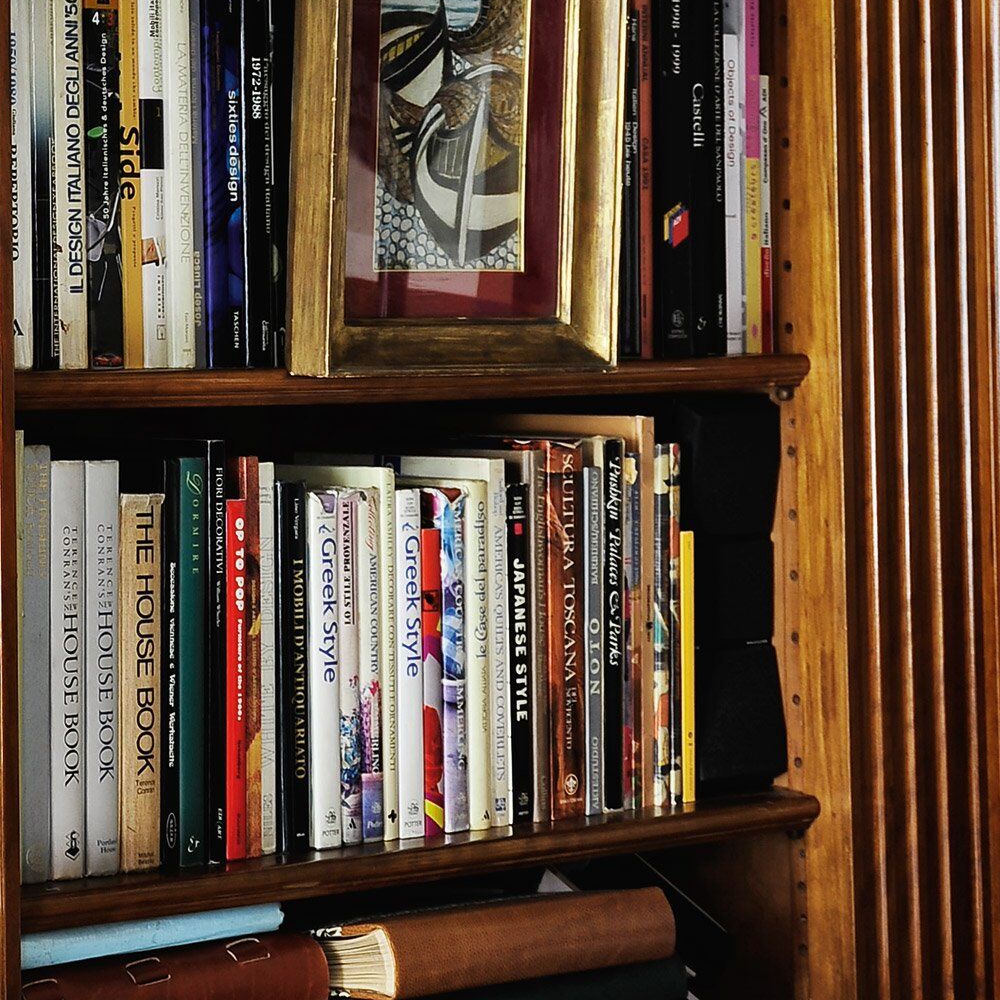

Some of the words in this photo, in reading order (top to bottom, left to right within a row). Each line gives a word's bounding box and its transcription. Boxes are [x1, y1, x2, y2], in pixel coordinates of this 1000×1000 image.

[64, 19, 80, 63] ANNI
[99, 32, 108, 64] Design
[176, 41, 188, 63] LA
[671, 43, 681, 75] 1999
[65, 61, 81, 119] DEGLI
[100, 67, 108, 112] deutsches
[177, 66, 190, 125] MATERIA
[251, 55, 263, 120] 1972-1988
[726, 59, 738, 106] Objects
[227, 89, 240, 144] sixties
[691, 82, 705, 148] Castelli
[728, 110, 738, 123] of
[66, 124, 82, 203] ITALIANO
[101, 124, 109, 180] italienisches
[118, 125, 141, 201] Side
[226, 145, 241, 202] design
[727, 125, 739, 168] Design
[102, 208, 110, 220] 50
[178, 131, 192, 263] DELL'INVENZIONE
[68, 208, 84, 275] DESIGN
[69, 279, 84, 293] IL
[232, 310, 240, 349] TASCHEN
[214, 466, 224, 499] FIORI
[293, 497, 301, 514] Lino
[562, 452, 576, 570] SCULTURA
[606, 456, 622, 521] Pushkin
[135, 504, 155, 564] THE
[186, 470, 204, 576] DORMIRE
[214, 501, 225, 574] DECORATIVI
[235, 516, 245, 541] OP
[342, 500, 351, 572] PROVENZALE
[365, 496, 378, 551] Collecting
[386, 519, 394, 558] ASHLEY
[475, 500, 489, 573] paradiso
[535, 496, 547, 600] Englishwoman's
[62, 525, 72, 603] CONRAN'S
[70, 525, 79, 605] TERENCE
[97, 523, 106, 601] CONRAN'S
[106, 523, 114, 603] TERENCE
[235, 546, 245, 570] TO
[260, 535, 274, 625] DESIGN
[321, 536, 338, 613] Greek
[368, 552, 379, 615] AMERICAN
[404, 535, 422, 610] Greek
[494, 524, 505, 600] AMERICA'S
[608, 527, 622, 586] Palaces
[168, 561, 177, 613] Secessione
[235, 575, 246, 611] POP
[291, 569, 304, 630] MOBILI
[343, 576, 351, 608] STILE
[387, 563, 396, 626] DECORARE
[474, 577, 488, 602] del
[512, 557, 527, 657] JAPANESE
[135, 574, 156, 679] HOUSE
[169, 617, 177, 659] viennese
[236, 617, 244, 662] Furniture
[343, 610, 352, 625] LO
[369, 617, 380, 675] COUNTRY
[387, 629, 396, 647] CON
[401, 616, 422, 679] Style
[473, 605, 488, 642] Case
[494, 602, 507, 655] QUILTS
[562, 576, 578, 681] TOSCANA
[608, 614, 623, 666] Parks
[62, 612, 80, 706] HOUSE
[96, 610, 115, 703] HOUSE
[318, 620, 339, 684] Style
[475, 644, 488, 658] le
[495, 658, 507, 692] AND
[589, 617, 601, 696] NOTO
[168, 673, 177, 708] Wiener
[236, 674, 244, 689] the
[291, 634, 306, 779] D'ANTIQUARIATO
[514, 662, 528, 723] STYLE
[63, 712, 81, 787] BOOK
[98, 709, 116, 783] BOOK
[135, 686, 156, 777] BOOK
[168, 711, 177, 768] Werkstaette
[260, 683, 275, 769] WHITE
[388, 703, 398, 772] ORNAMENTI
[495, 694, 508, 783] COVERLETS
